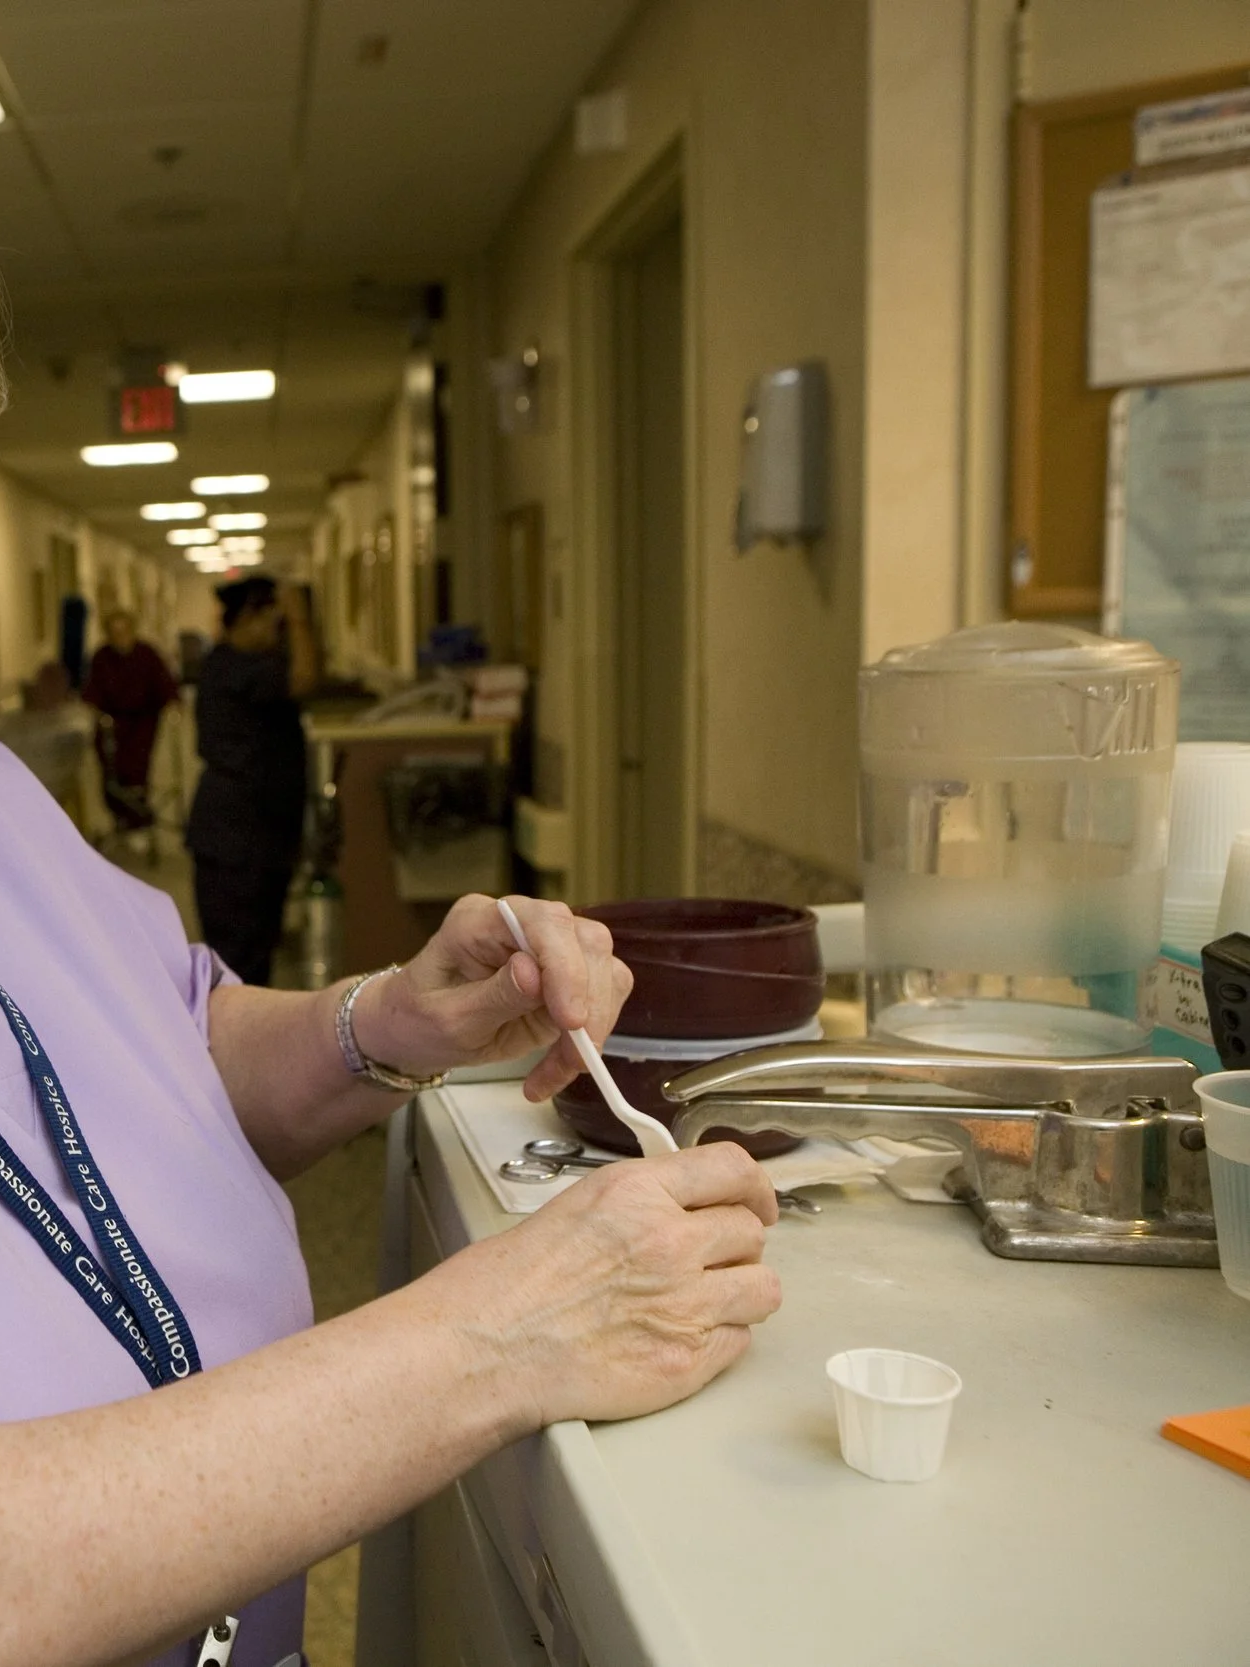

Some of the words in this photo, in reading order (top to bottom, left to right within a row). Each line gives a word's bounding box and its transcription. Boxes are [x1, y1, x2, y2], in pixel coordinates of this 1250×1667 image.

[43, 1076, 82, 1155] Hospice
[78, 1162, 107, 1212] Care
[75, 1256, 113, 1305] Care
[104, 1218, 190, 1378] Compassionate
